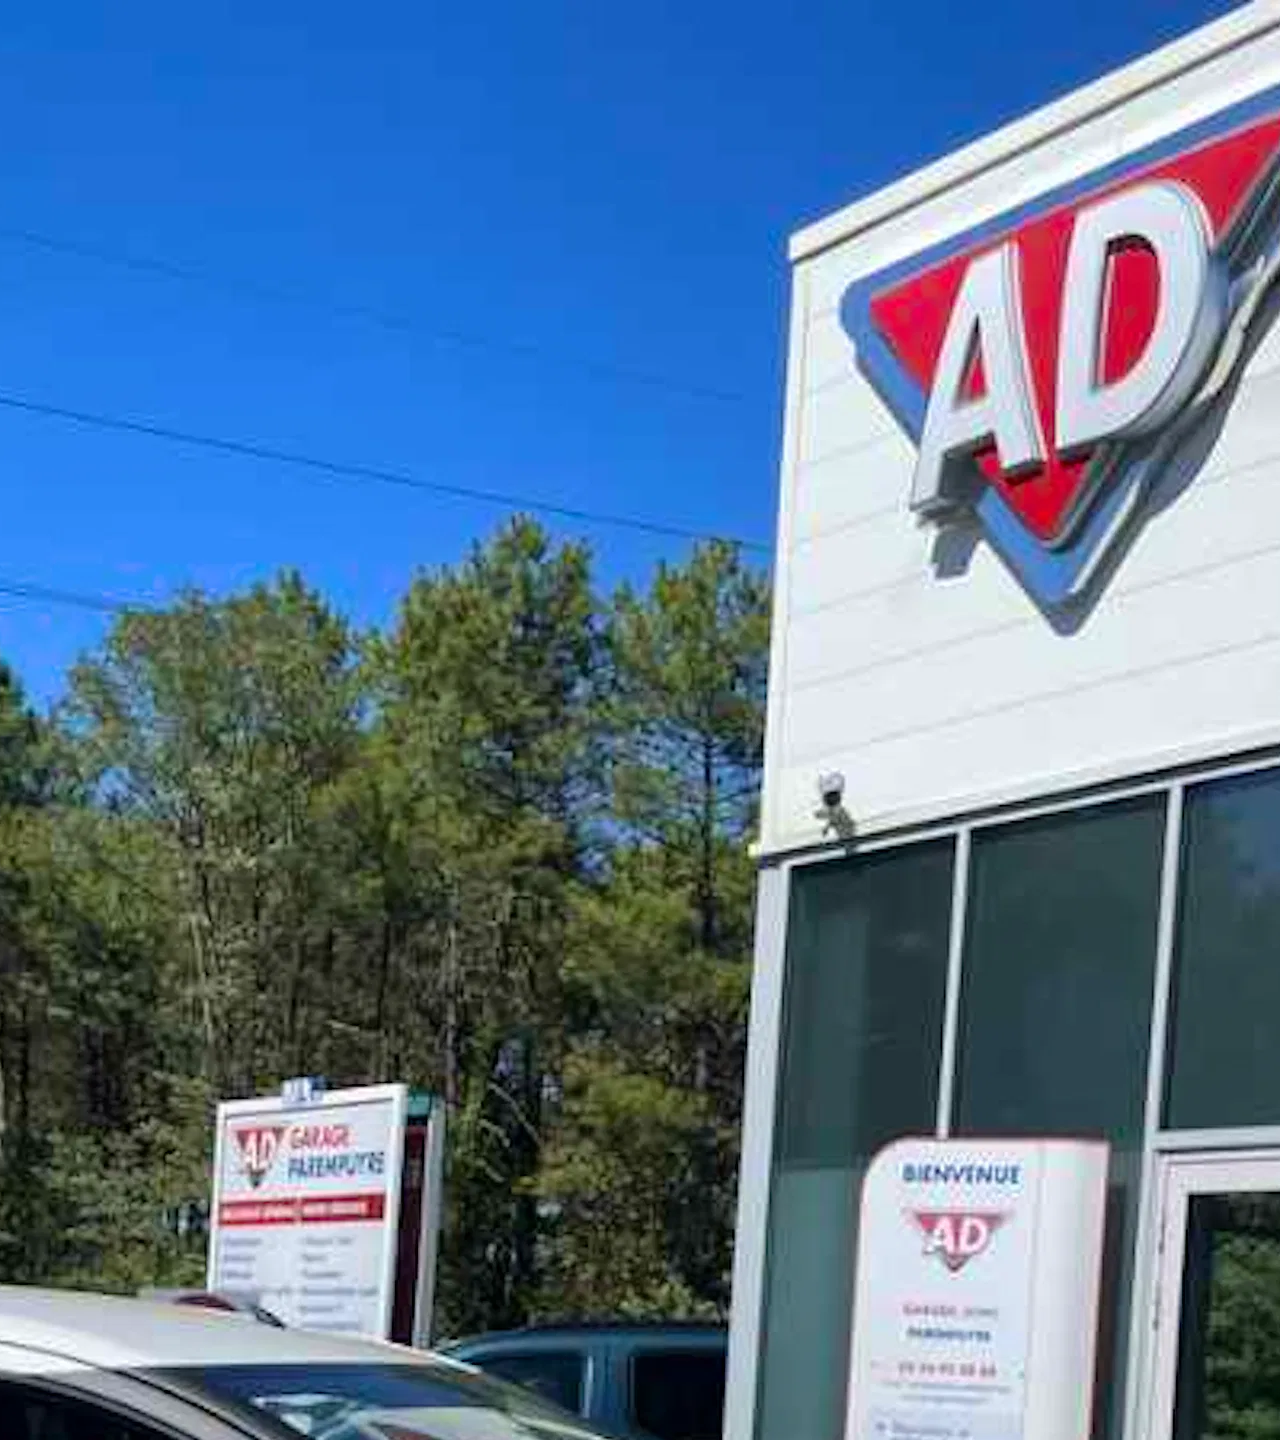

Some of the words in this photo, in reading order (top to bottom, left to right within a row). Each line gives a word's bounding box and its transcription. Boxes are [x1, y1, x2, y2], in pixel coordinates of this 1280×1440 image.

[910, 178, 1225, 505] AD
[902, 1163, 1020, 1184] BIENVENUE
[925, 1216, 988, 1253] AD
